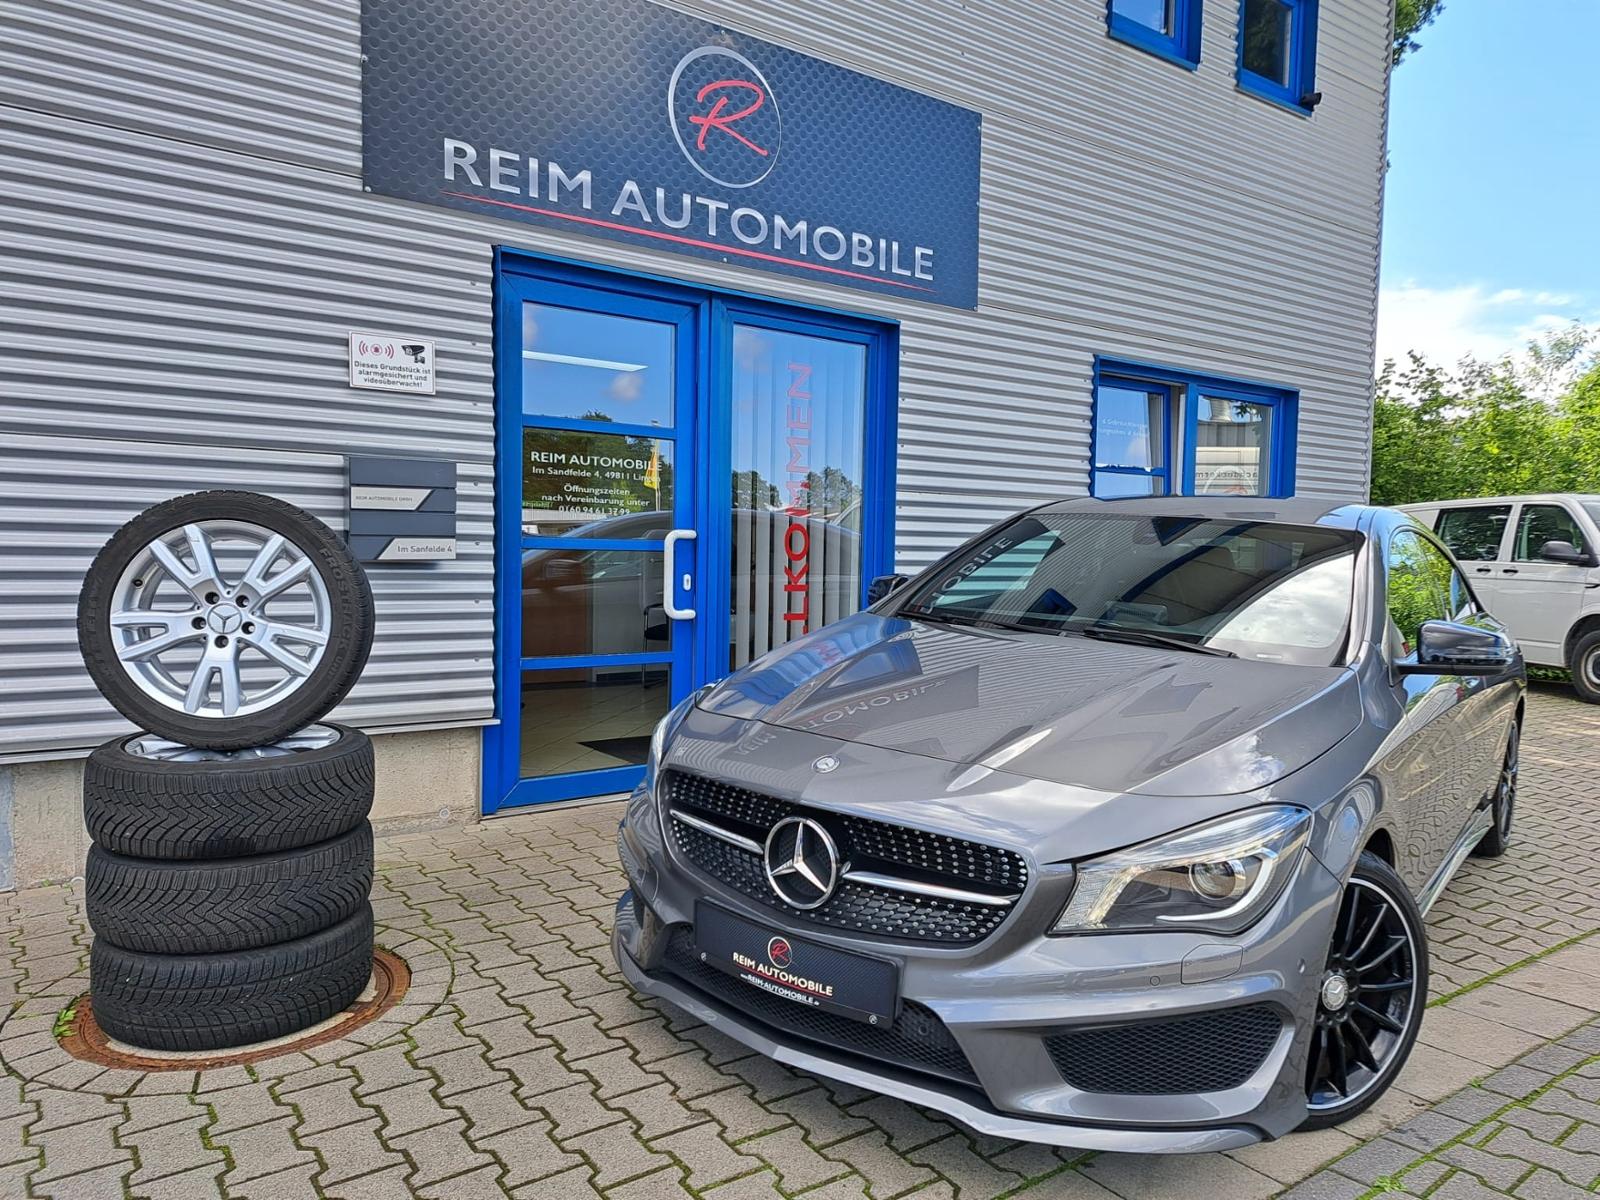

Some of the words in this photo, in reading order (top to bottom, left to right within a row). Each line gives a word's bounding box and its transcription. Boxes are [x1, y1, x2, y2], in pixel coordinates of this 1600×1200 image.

[689, 81, 768, 155] R
[443, 137, 592, 209] REIM
[611, 180, 934, 281] AUTOMOBILE
[354, 361, 379, 370] Dieses
[380, 364, 421, 374] Grundstück
[358, 369, 413, 380] alarmgesichert
[364, 377, 423, 388] videoüberwacht!
[531, 451, 566, 464] REIM
[569, 454, 662, 472] AUTOMOBILE
[532, 466, 545, 474] Im
[547, 467, 591, 478] Sandfelde
[605, 471, 630, 480] 49811
[563, 483, 631, 496] Öffnungszeiten
[541, 493, 563, 502] nach
[564, 494, 624, 507] Vereinbarung
[626, 499, 650, 507] unter
[784, 362, 813, 636] LKOMMEN
[411, 545, 446, 553] Sanfelde
[447, 545, 453, 553] 4
[733, 952, 756, 970] REIM
[757, 962, 833, 997] AUTOMOBILE
